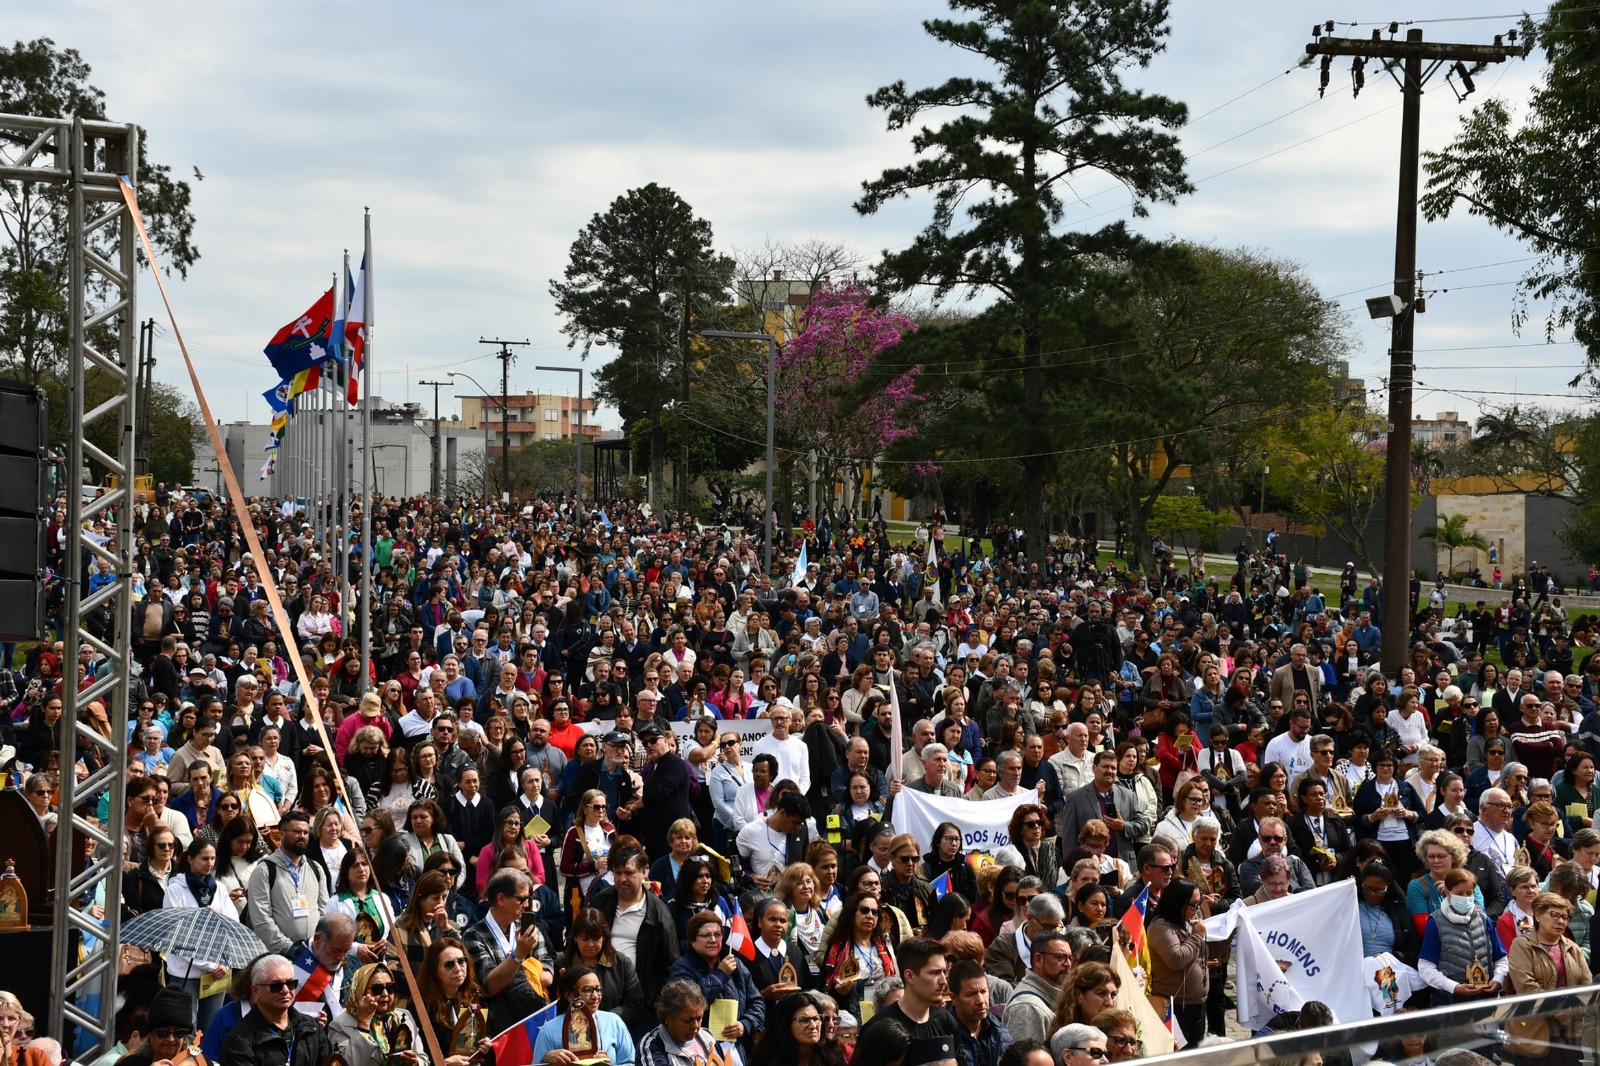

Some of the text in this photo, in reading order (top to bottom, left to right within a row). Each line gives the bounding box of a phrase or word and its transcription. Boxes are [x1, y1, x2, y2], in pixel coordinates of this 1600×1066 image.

[742, 732, 767, 742] ANOS
[740, 746, 753, 756] ENS
[964, 829, 989, 846] DOS
[1266, 930, 1321, 977] HOMENS
